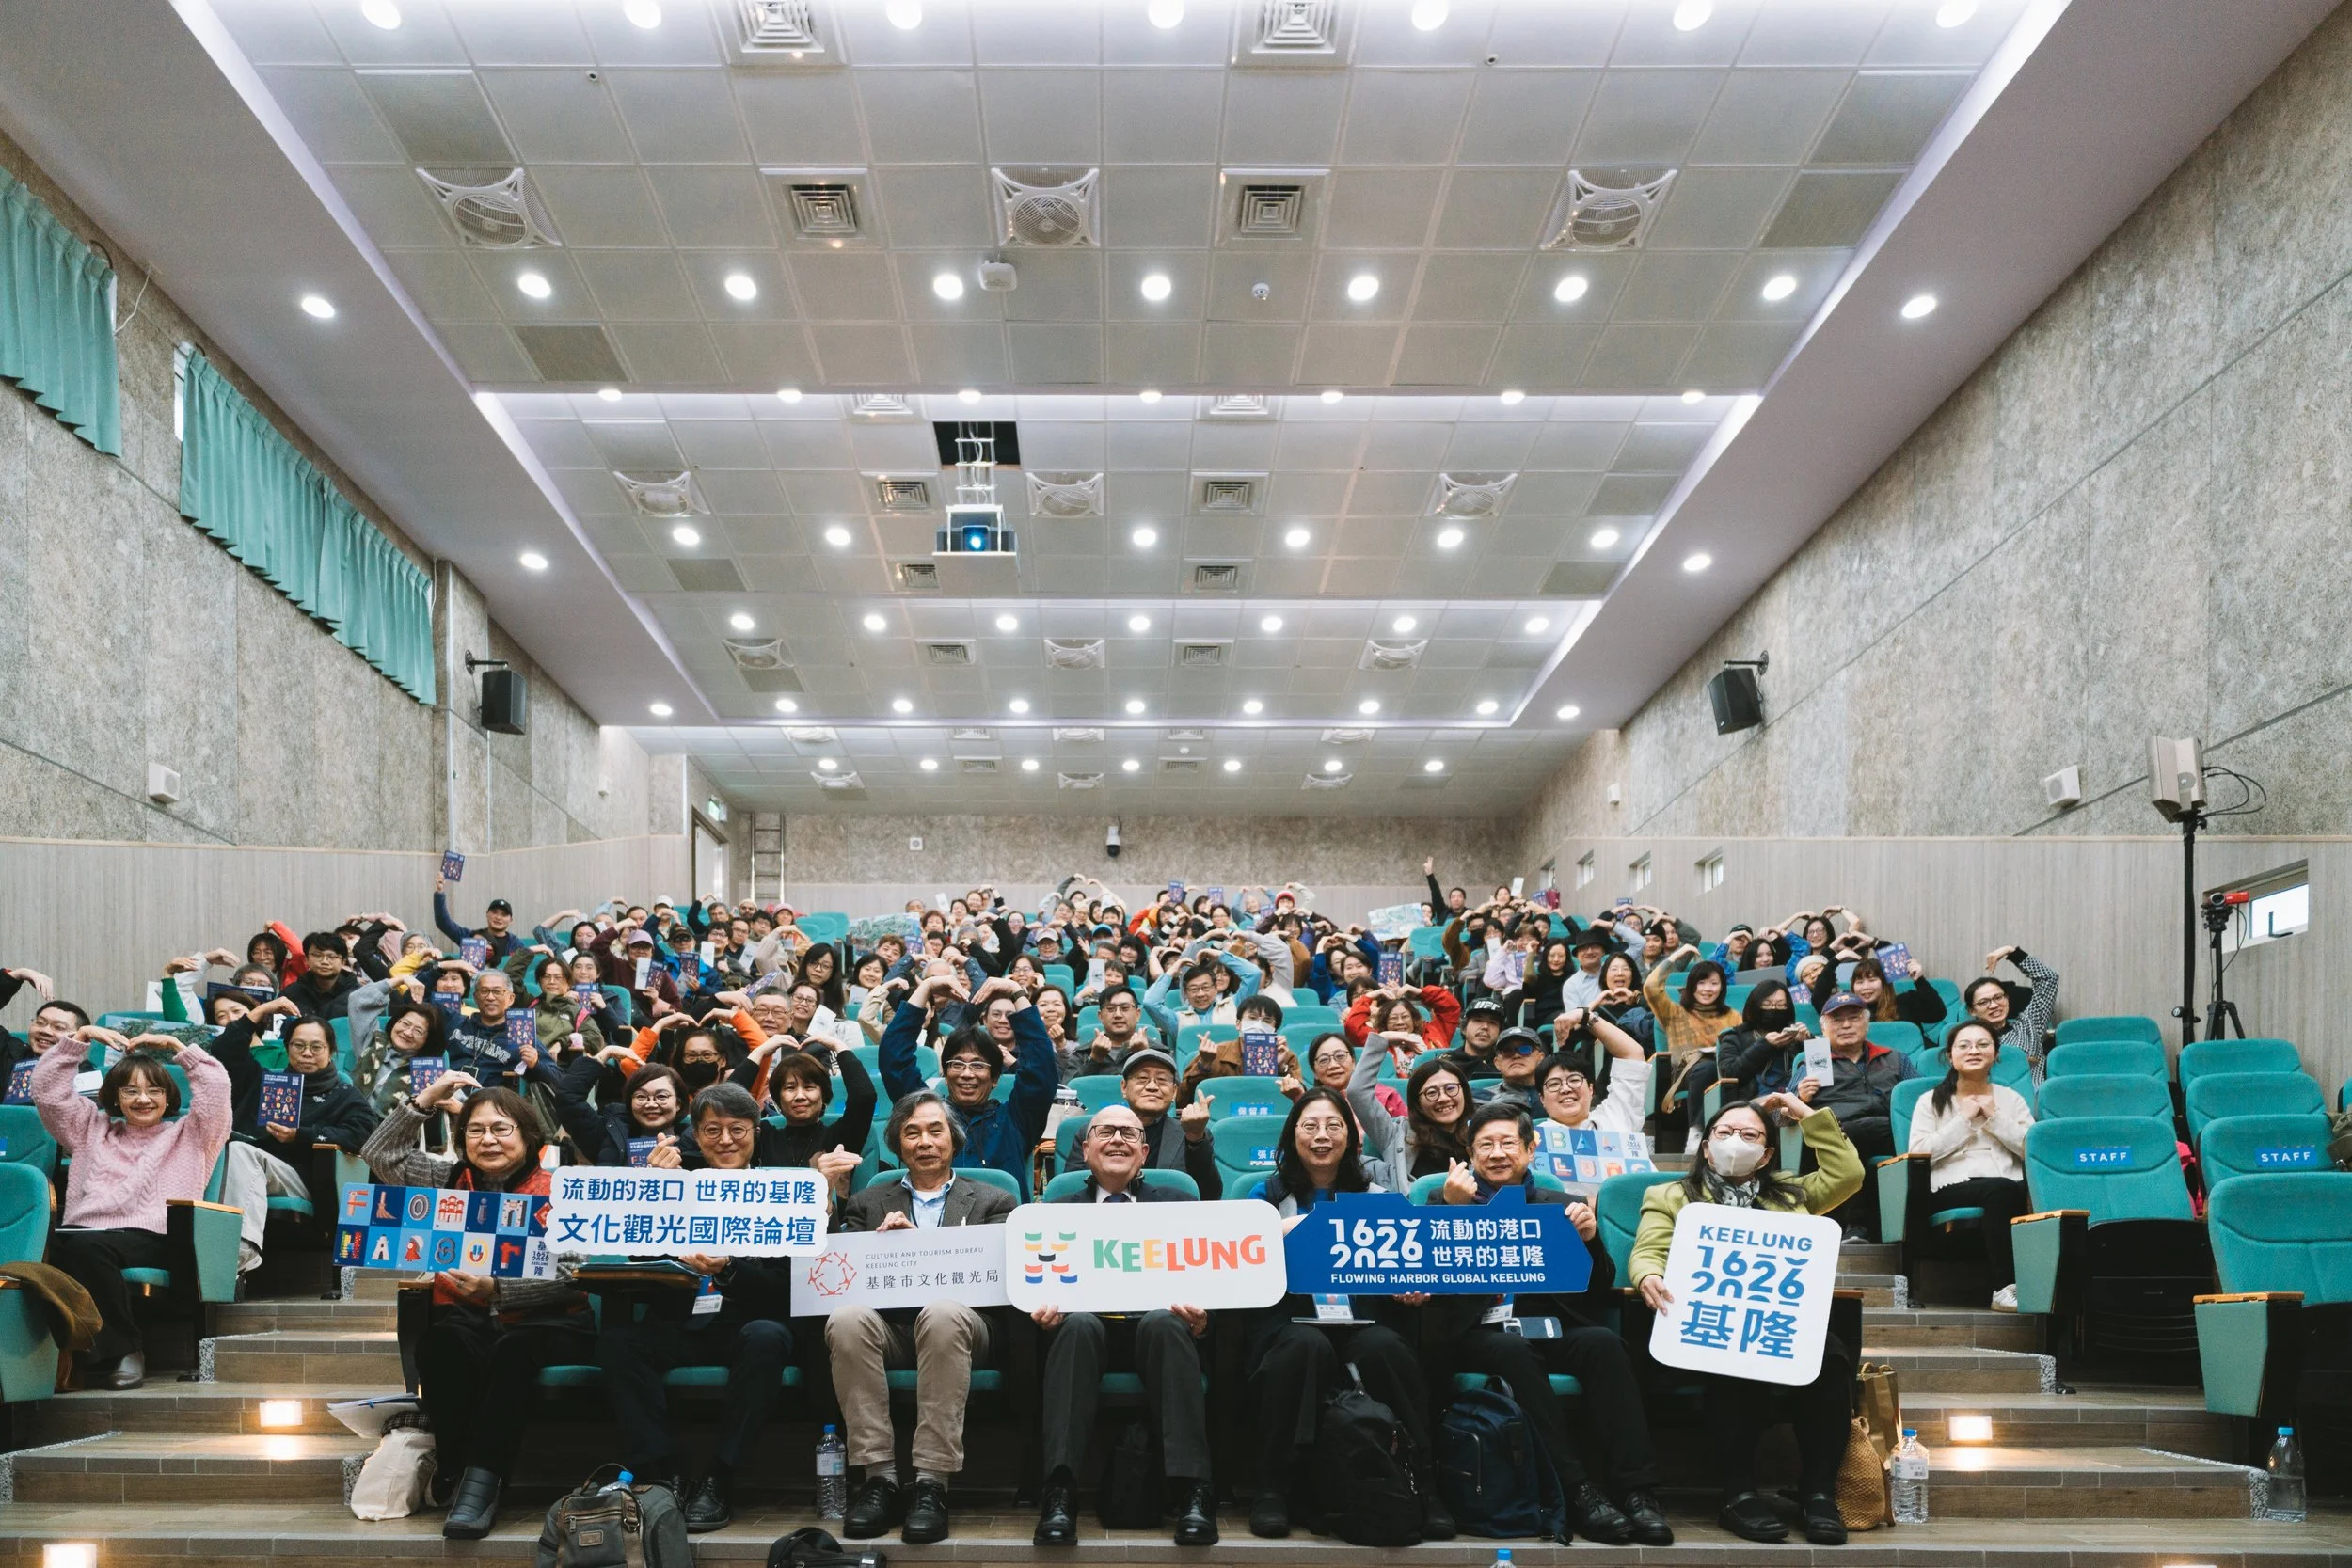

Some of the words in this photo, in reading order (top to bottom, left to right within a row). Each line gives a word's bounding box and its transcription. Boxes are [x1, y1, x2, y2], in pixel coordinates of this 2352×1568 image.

[2079, 1151, 2127, 1163] STAFF
[2261, 1151, 2312, 1163] STAFF
[562, 1177, 685, 1202] 流動的港口
[695, 1180, 817, 1205] 世界的基隆
[556, 1212, 817, 1246] 文化觀光國際論壇
[1429, 1218, 1542, 1241] 流動的港口
[1699, 1225, 1813, 1252] KEELUNG
[955, 1246, 984, 1255] BUREAU
[1093, 1234, 1266, 1273] KEELUNG
[1431, 1245, 1546, 1268] 世界的基隆
[866, 1269, 999, 1290] 基隆市文化觀光局
[1330, 1273, 1386, 1284] FLOWING
[1390, 1273, 1438, 1284] HARBOR
[1442, 1273, 1488, 1283] GLOBAL
[1490, 1272, 1546, 1283] KEELUNG
[1680, 1300, 1798, 1360] 基隆
